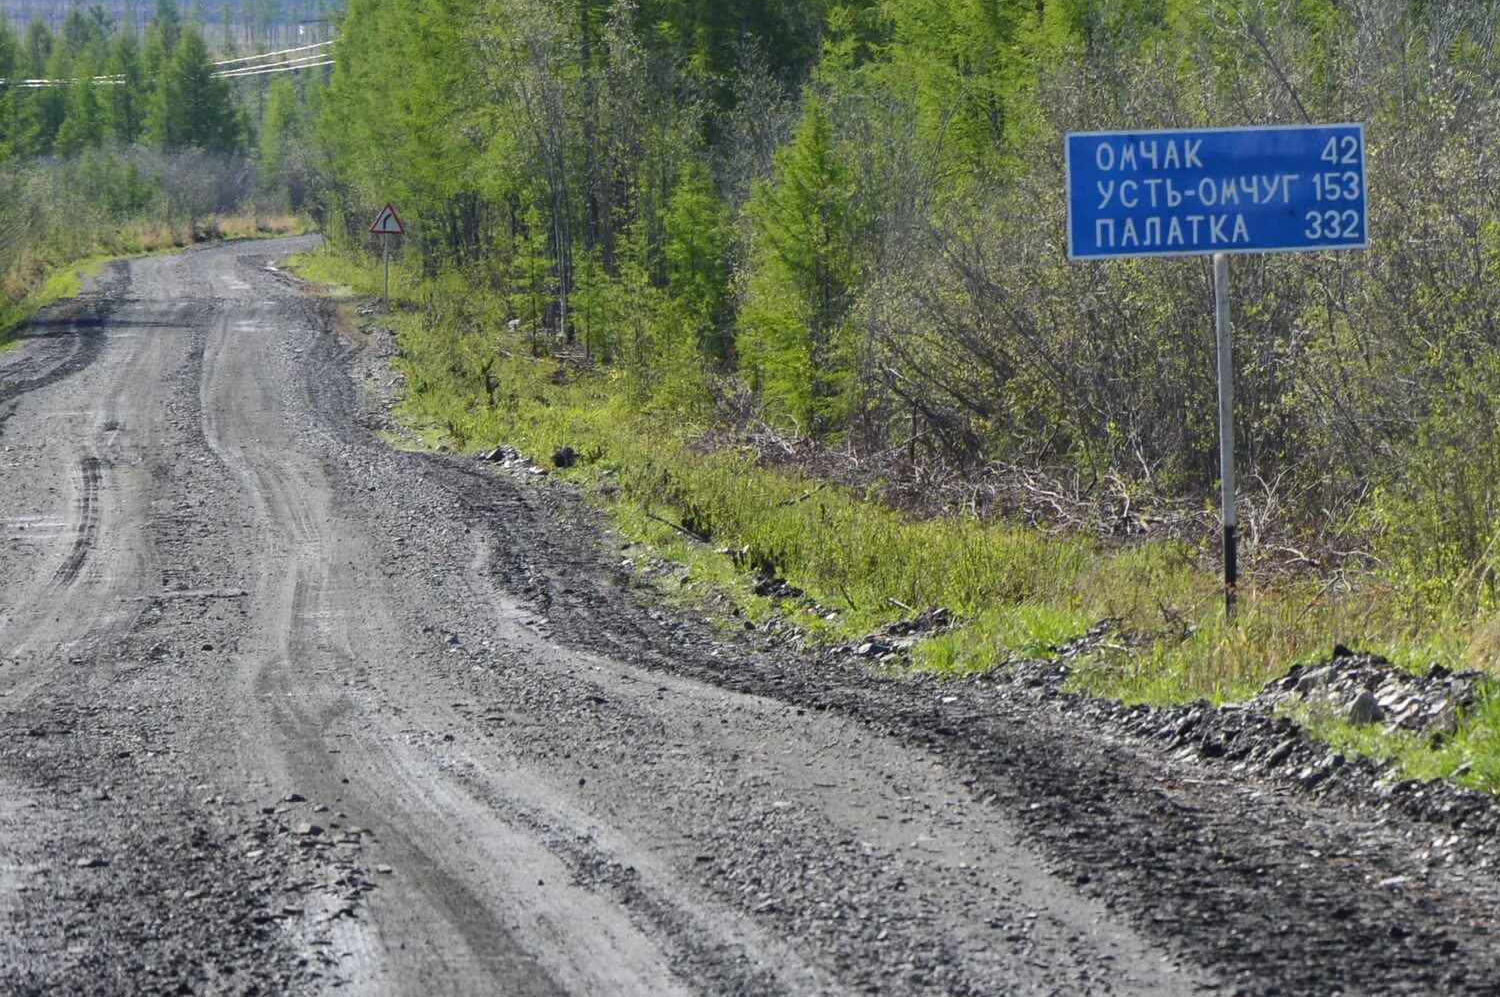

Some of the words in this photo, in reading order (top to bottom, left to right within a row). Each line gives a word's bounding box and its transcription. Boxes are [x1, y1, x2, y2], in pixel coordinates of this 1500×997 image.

[1096, 139, 1204, 171] ОМЧАК
[1321, 135, 1359, 164] 42
[1097, 174, 1299, 209] УСТЬ-ОМЧУГ
[1312, 171, 1360, 201] 153
[1095, 214, 1250, 247] ПАЛАТКА
[1304, 209, 1360, 239] 332
